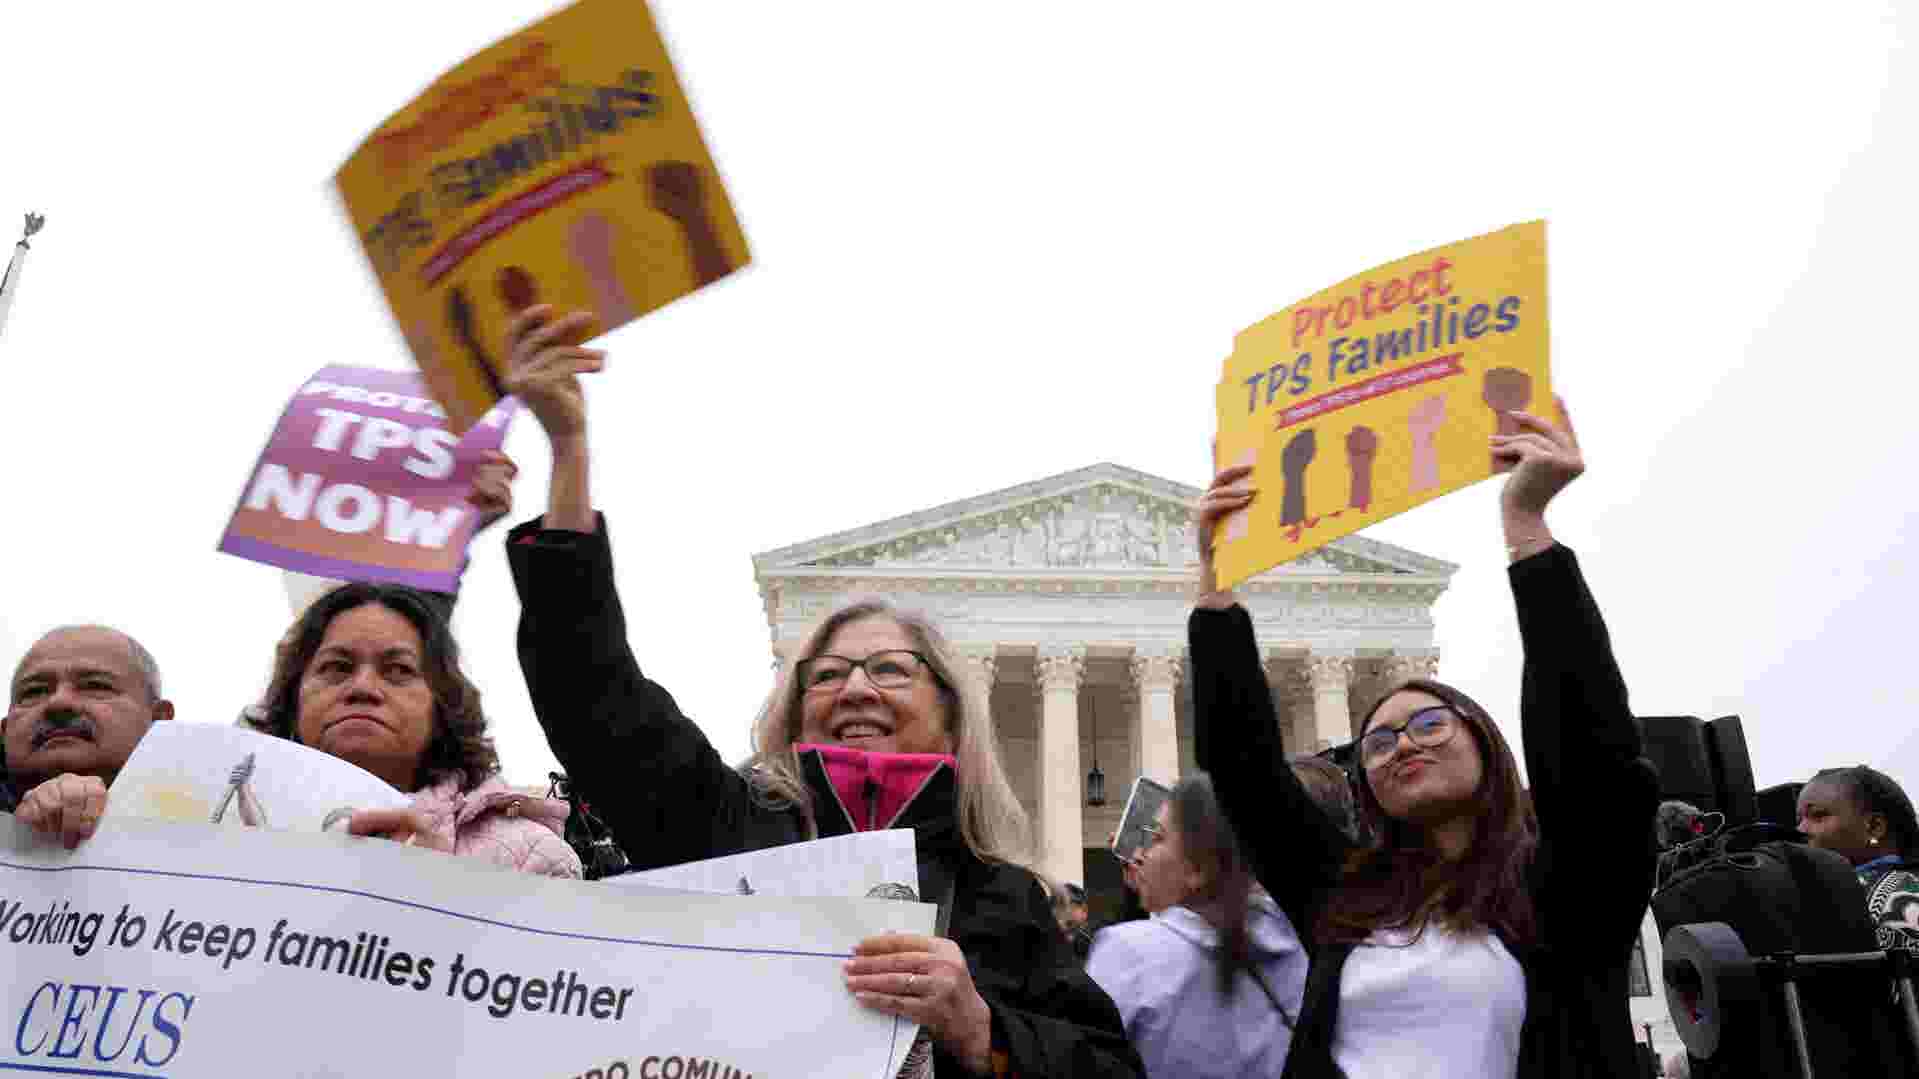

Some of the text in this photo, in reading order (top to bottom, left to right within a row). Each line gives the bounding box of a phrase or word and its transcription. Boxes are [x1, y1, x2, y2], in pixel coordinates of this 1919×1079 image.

[1243, 351, 1312, 413] TPS
[1328, 295, 1521, 381] Families
[311, 408, 458, 480] TPS
[246, 463, 463, 549] NOW
[108, 903, 147, 948] to
[153, 909, 256, 969] keep
[264, 919, 434, 991] families
[447, 953, 633, 1021] together
[15, 981, 195, 1067] CEUS
